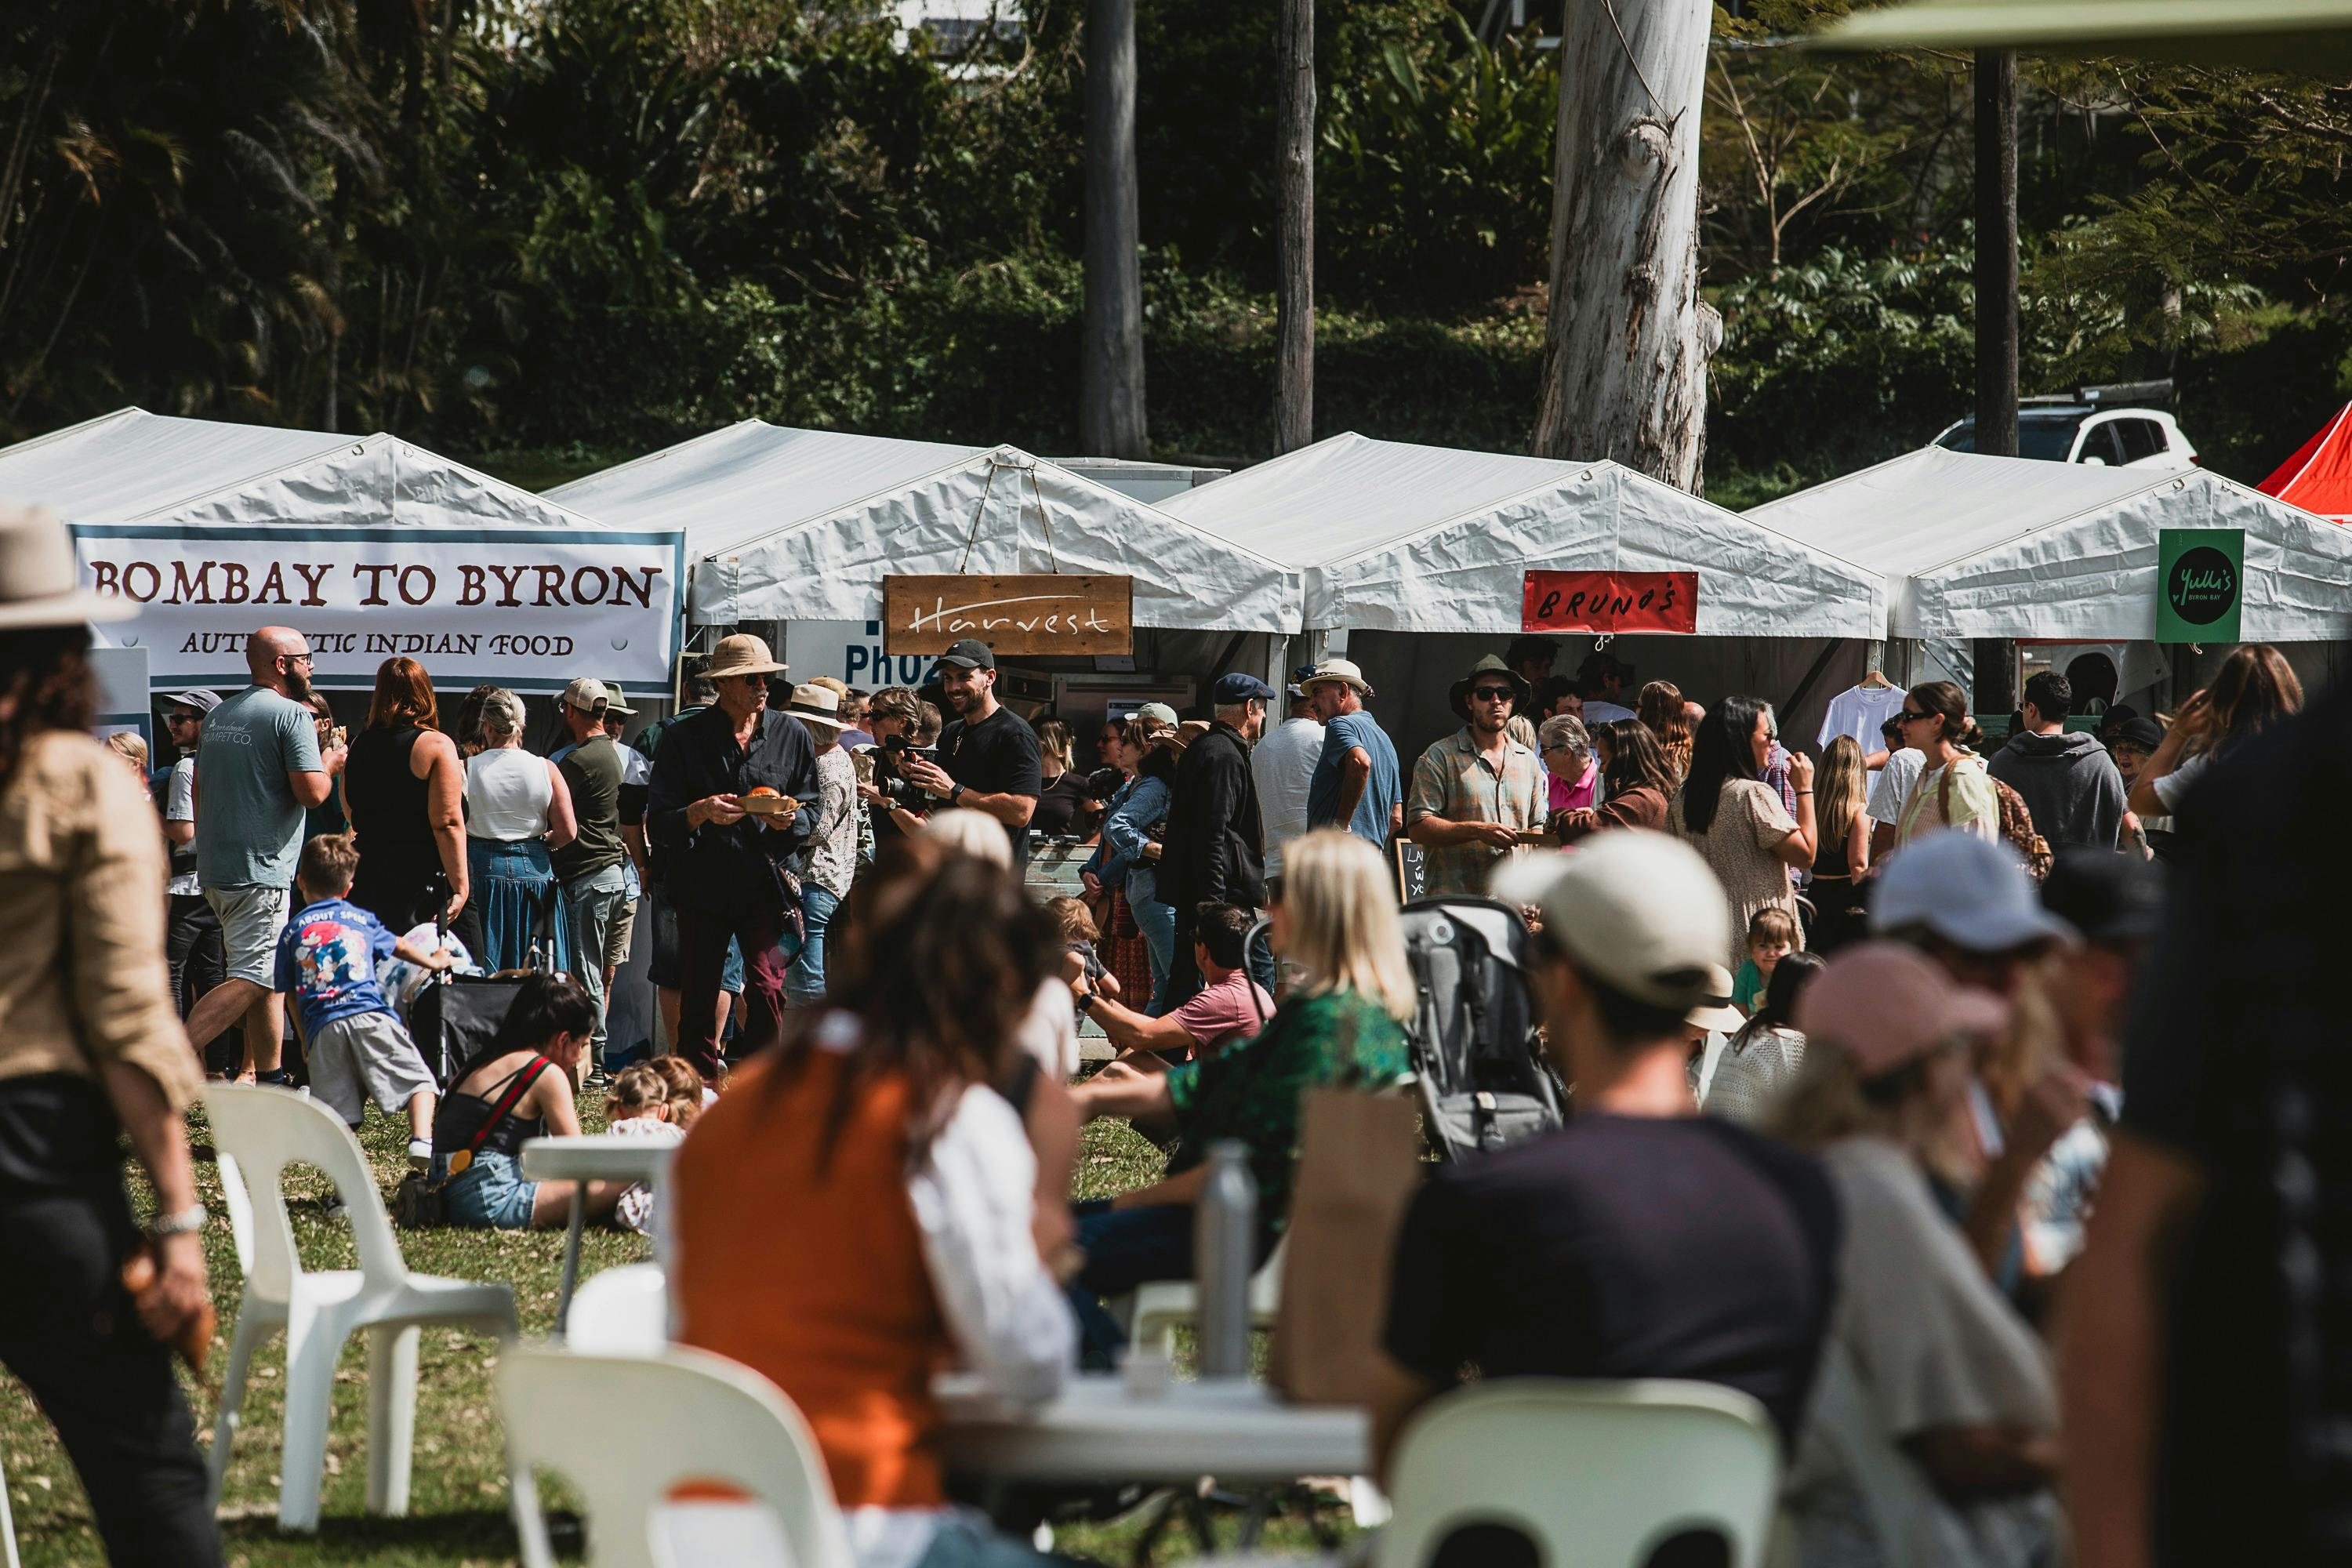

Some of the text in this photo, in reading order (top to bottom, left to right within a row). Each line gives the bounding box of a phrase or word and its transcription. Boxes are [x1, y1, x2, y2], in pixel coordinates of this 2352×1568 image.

[90, 561, 662, 608] BOMBAY TO BYRON
[1537, 580, 1675, 619] BRUNO'S
[909, 596, 1109, 635] Harvest
[180, 633, 574, 656] AUTTIC INDIAN FOOD
[233, 732, 252, 746] CO.
[299, 911, 335, 927] ABOUT
